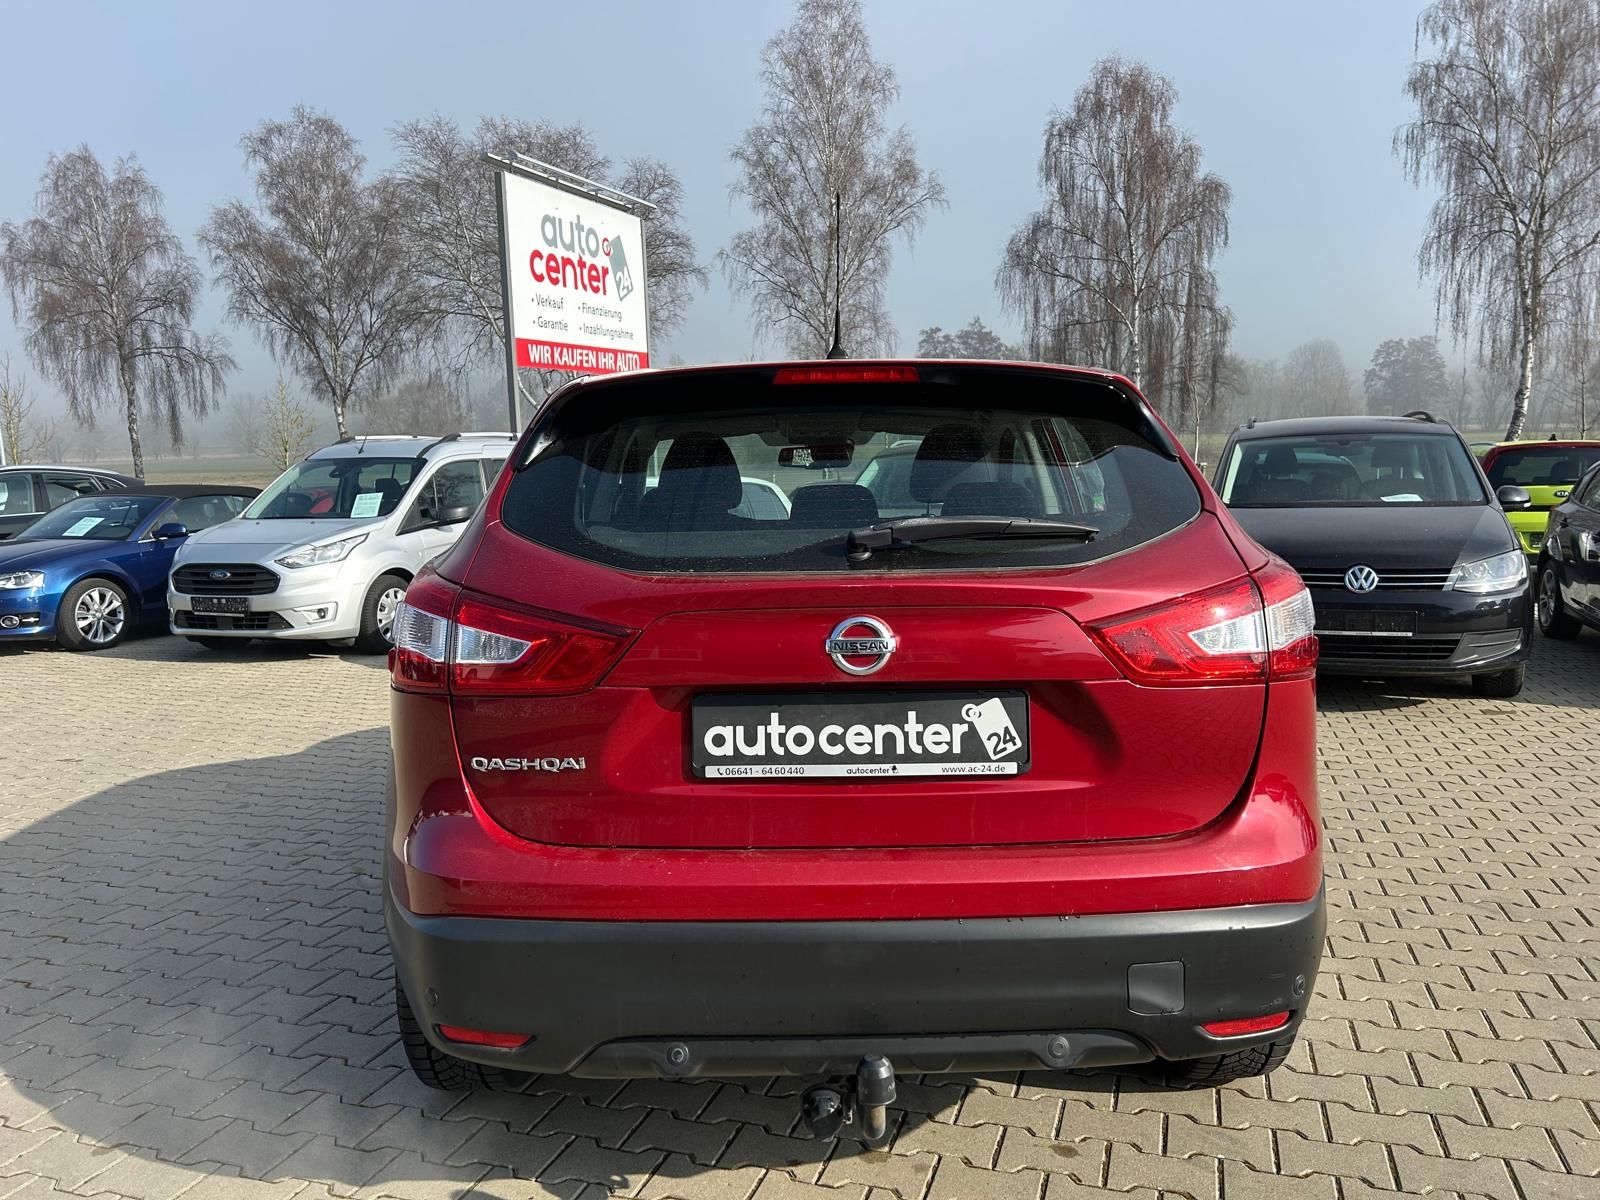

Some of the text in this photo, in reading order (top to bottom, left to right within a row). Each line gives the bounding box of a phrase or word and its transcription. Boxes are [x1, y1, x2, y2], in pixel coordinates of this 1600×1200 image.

[541, 214, 600, 258] auto
[529, 249, 609, 296] center
[616, 267, 631, 298] 24
[535, 293, 564, 310] Verkauf
[581, 302, 622, 322] Finanzierung
[537, 316, 568, 331] Garantie
[583, 323, 634, 340] Inzahlungnahme
[528, 343, 640, 372] WIR KAUFEN IHR AUTO
[833, 641, 889, 651] NISSAN
[986, 725, 1017, 756] 24
[725, 767, 753, 776] 06641
[846, 766, 890, 775] autocenter
[941, 765, 1006, 774] www.ac-24.de
